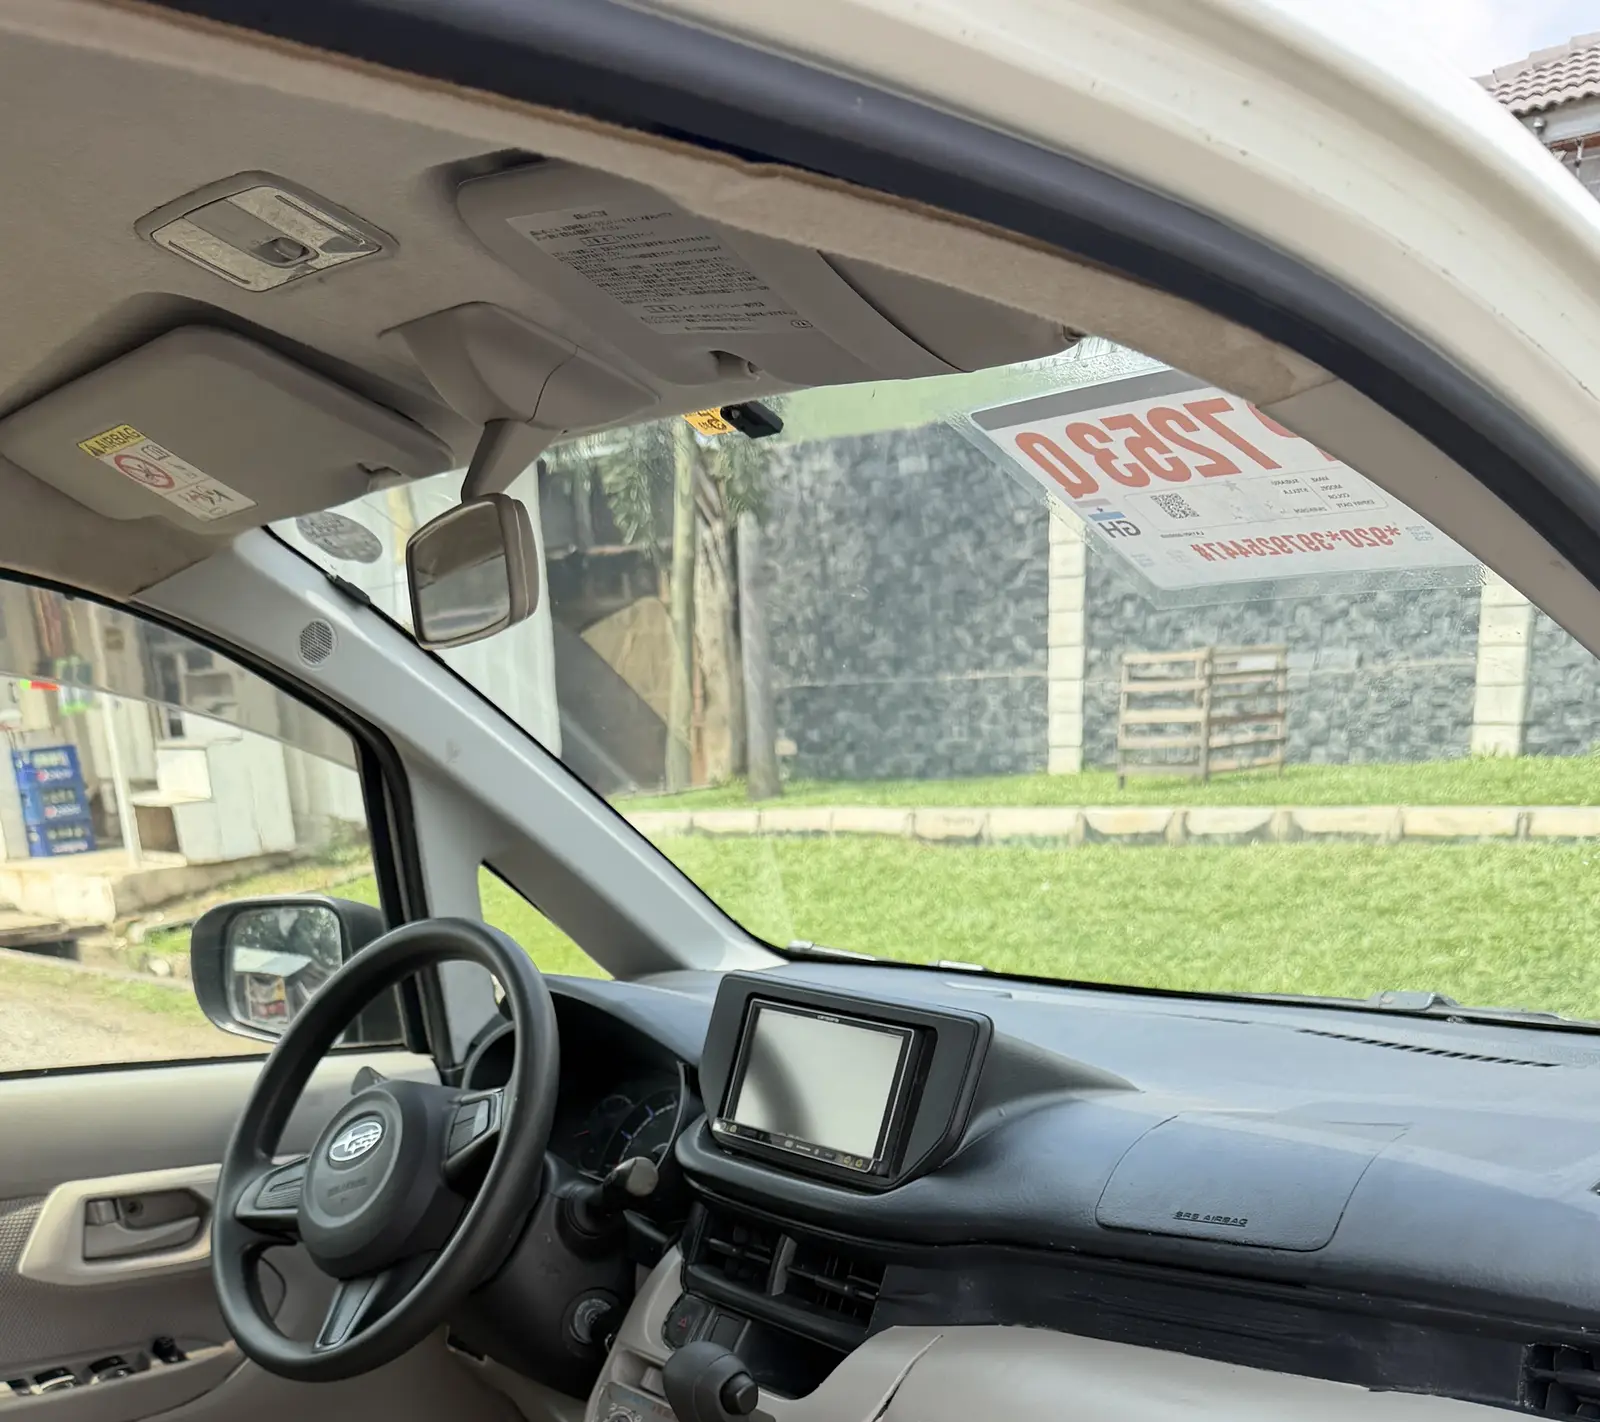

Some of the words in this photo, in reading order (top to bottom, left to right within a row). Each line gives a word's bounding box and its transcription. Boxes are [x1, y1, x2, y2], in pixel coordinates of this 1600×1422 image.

[94, 427, 142, 452] AIRBAG
[1175, 1211, 1200, 1220] SRS
[1203, 1214, 1249, 1226] AIRBAG
